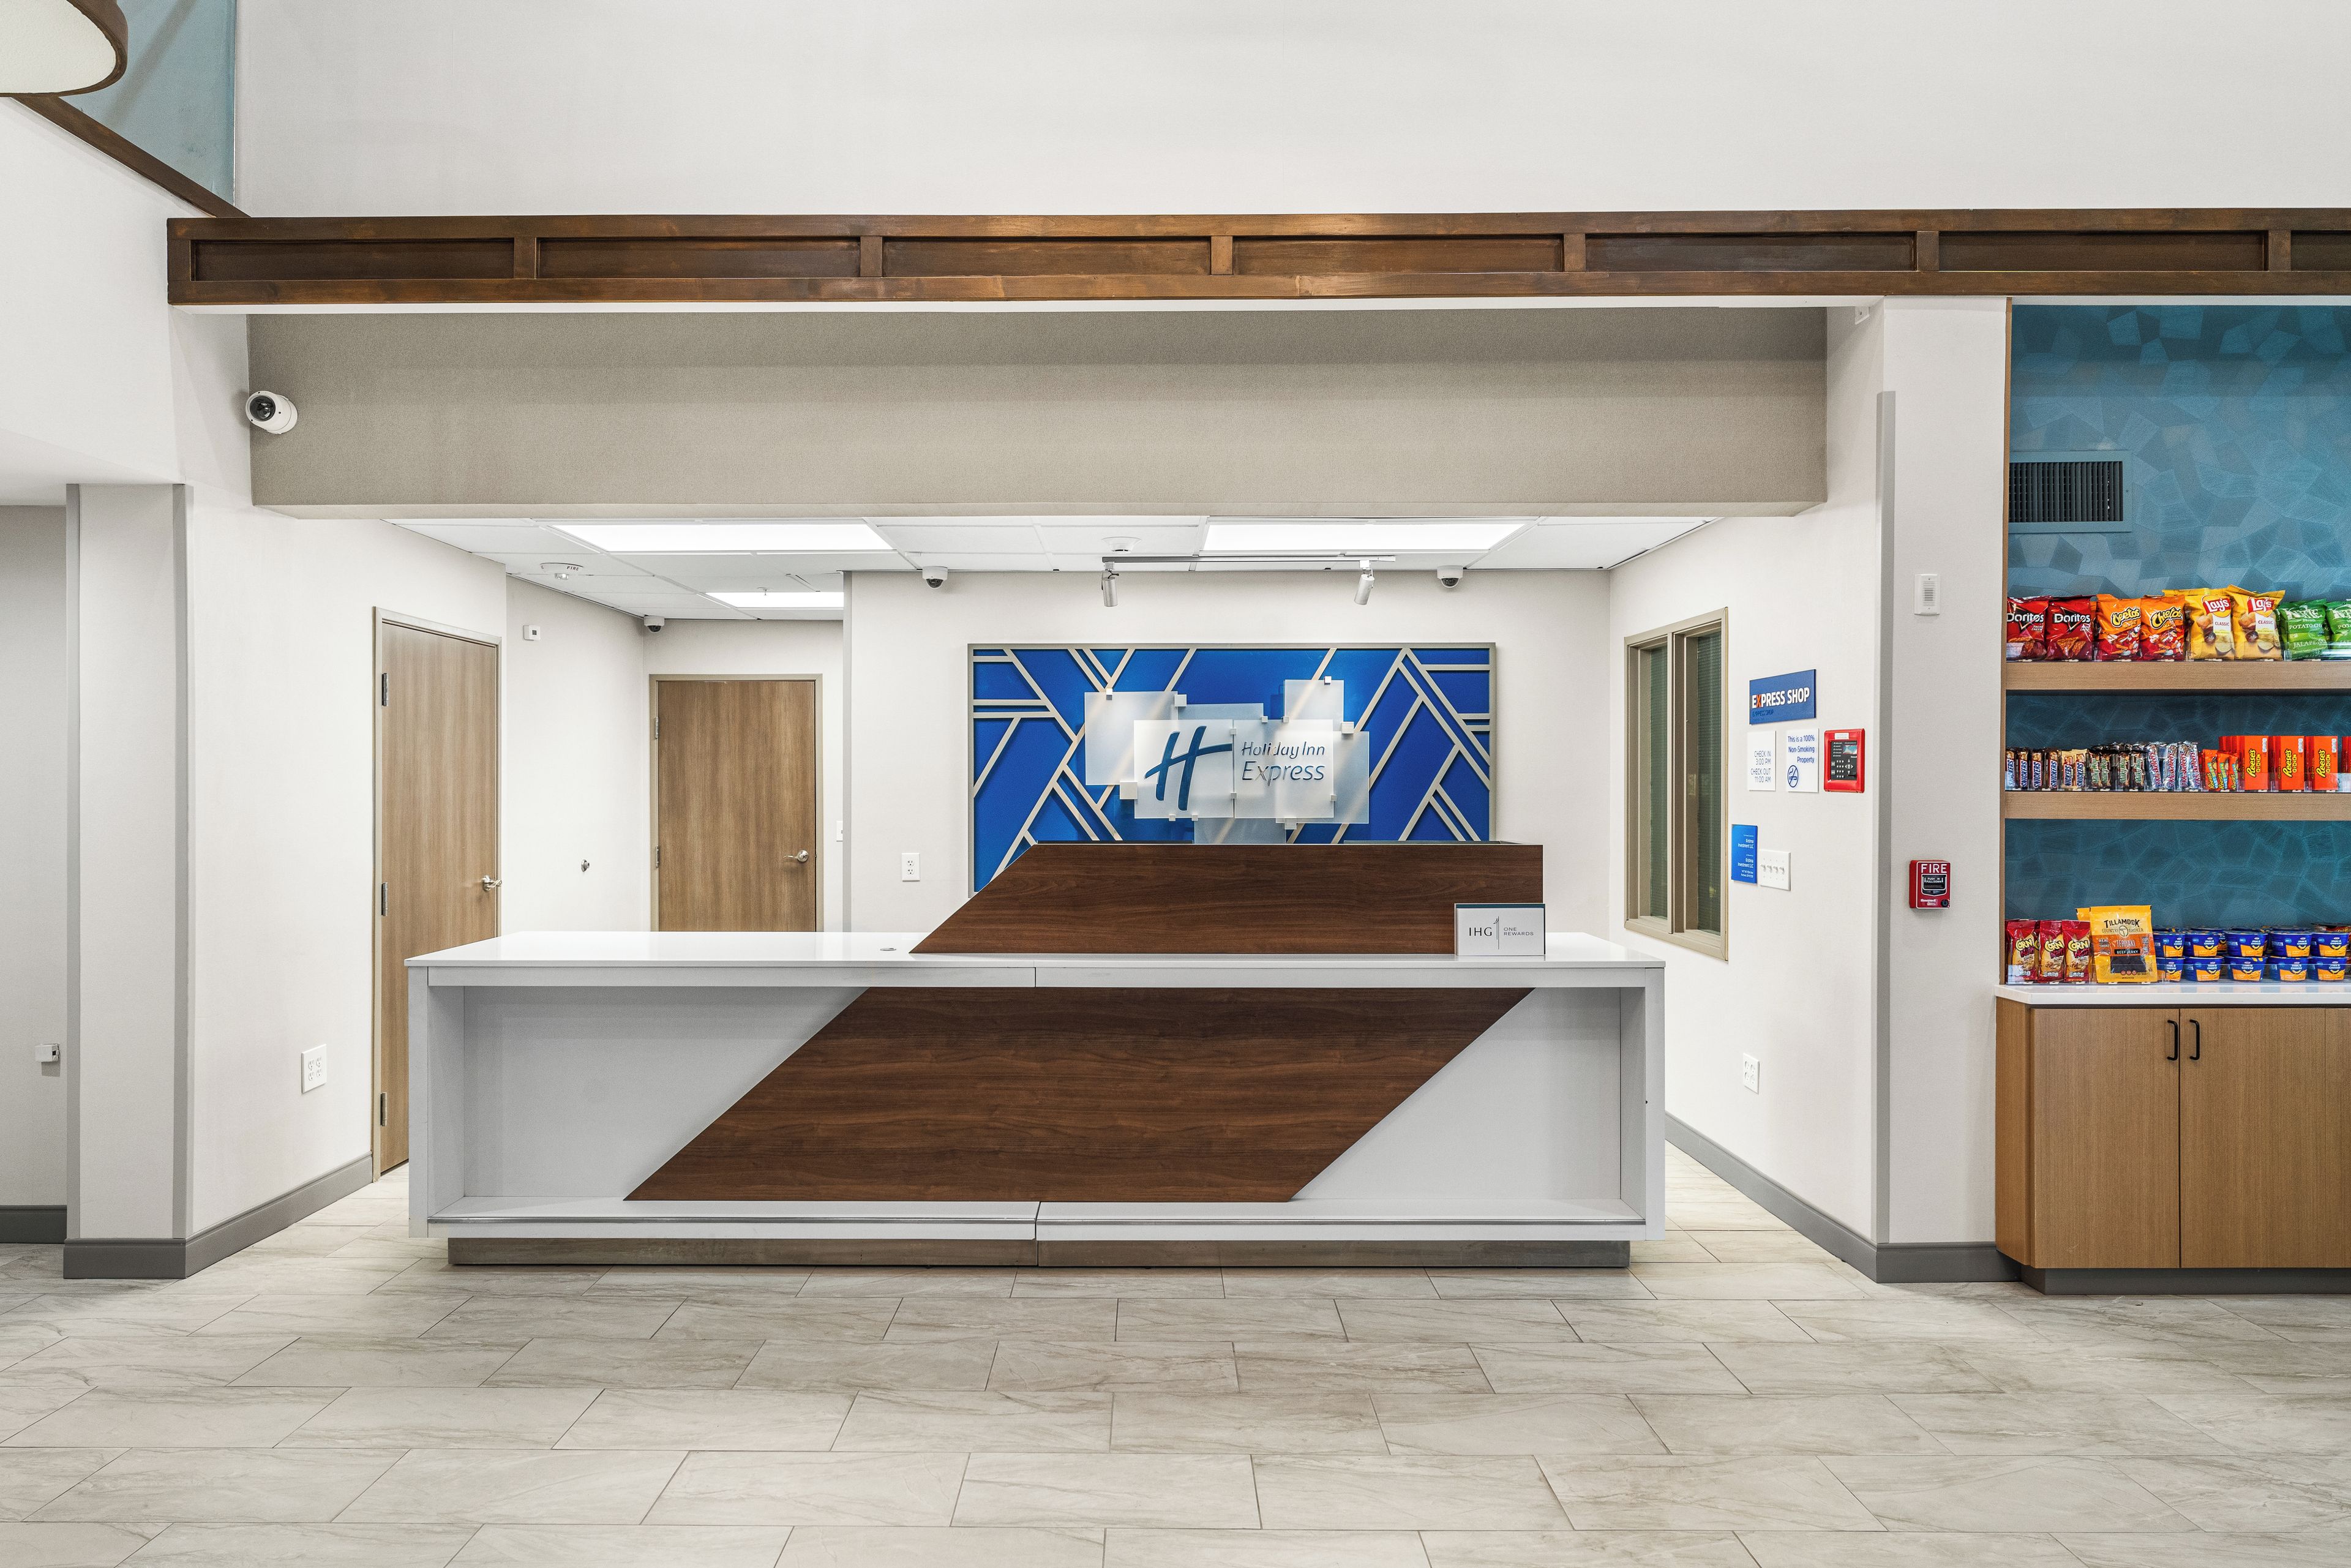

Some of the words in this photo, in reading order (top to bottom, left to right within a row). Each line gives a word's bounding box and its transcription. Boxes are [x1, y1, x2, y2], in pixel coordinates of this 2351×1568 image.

[2204, 598, 2230, 613] Lay's
[2007, 613, 2044, 622] Doritos
[2054, 613, 2091, 623] Doritos
[2151, 607, 2183, 629] Cheetos
[1752, 691, 1785, 708] EXPRESS
[1787, 687, 1810, 704] SHOP
[1242, 741, 1299, 759] Holiday
[1302, 741, 1325, 756] Inn
[2246, 748, 2257, 778] Reese's
[2282, 748, 2292, 778] Reese's
[2315, 748, 2326, 778] Reese's
[1242, 760, 1325, 787] Express
[2033, 761, 2041, 788] SNICKERS
[1921, 864, 1947, 873] FIRE
[2104, 918, 2140, 928] TILLAMOOK
[1469, 927, 1492, 936] IHG
[2015, 938, 2033, 951] CORN
[2044, 940, 2064, 952] CORN
[2068, 940, 2090, 951] CORN
